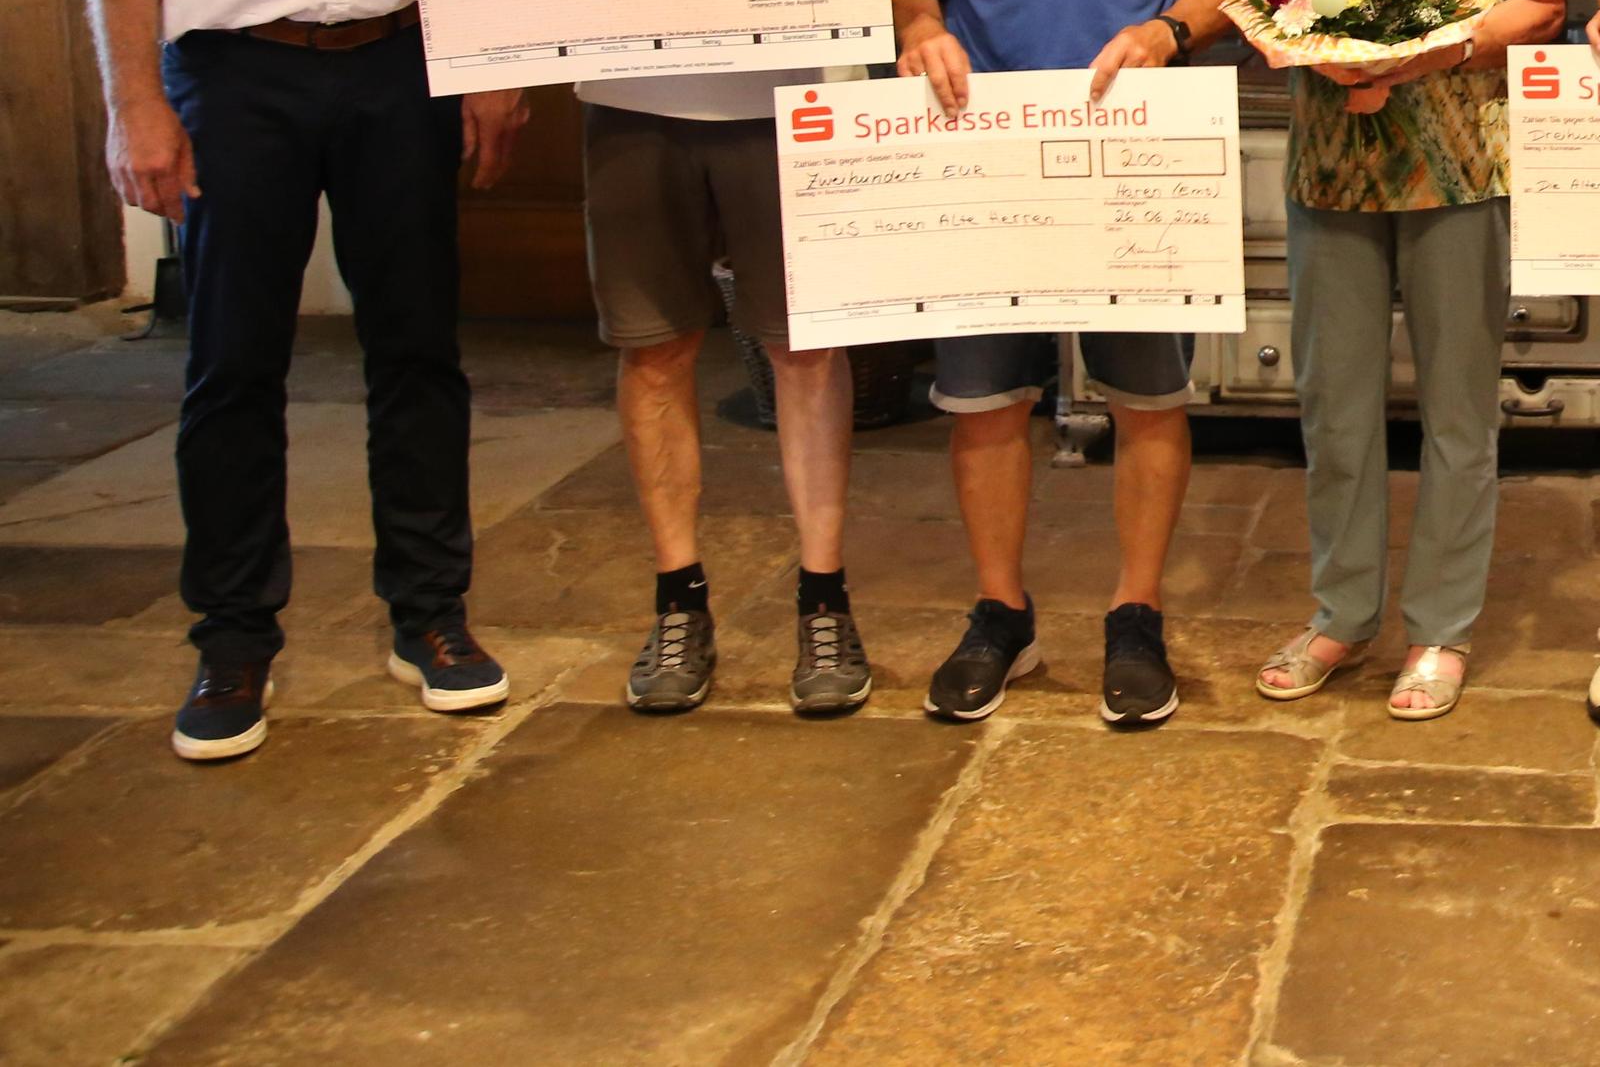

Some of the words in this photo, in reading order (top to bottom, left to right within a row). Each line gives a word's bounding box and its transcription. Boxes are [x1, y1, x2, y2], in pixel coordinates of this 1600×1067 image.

[855, 107, 1011, 143] Sparkasse
[1023, 100, 1147, 128] Emsland
[1056, 154, 1079, 164] EUR
[942, 164, 986, 179] EUR
[1116, 182, 1162, 199] Haren
[1174, 209, 1211, 224] 2026
[875, 217, 925, 232] Haren
